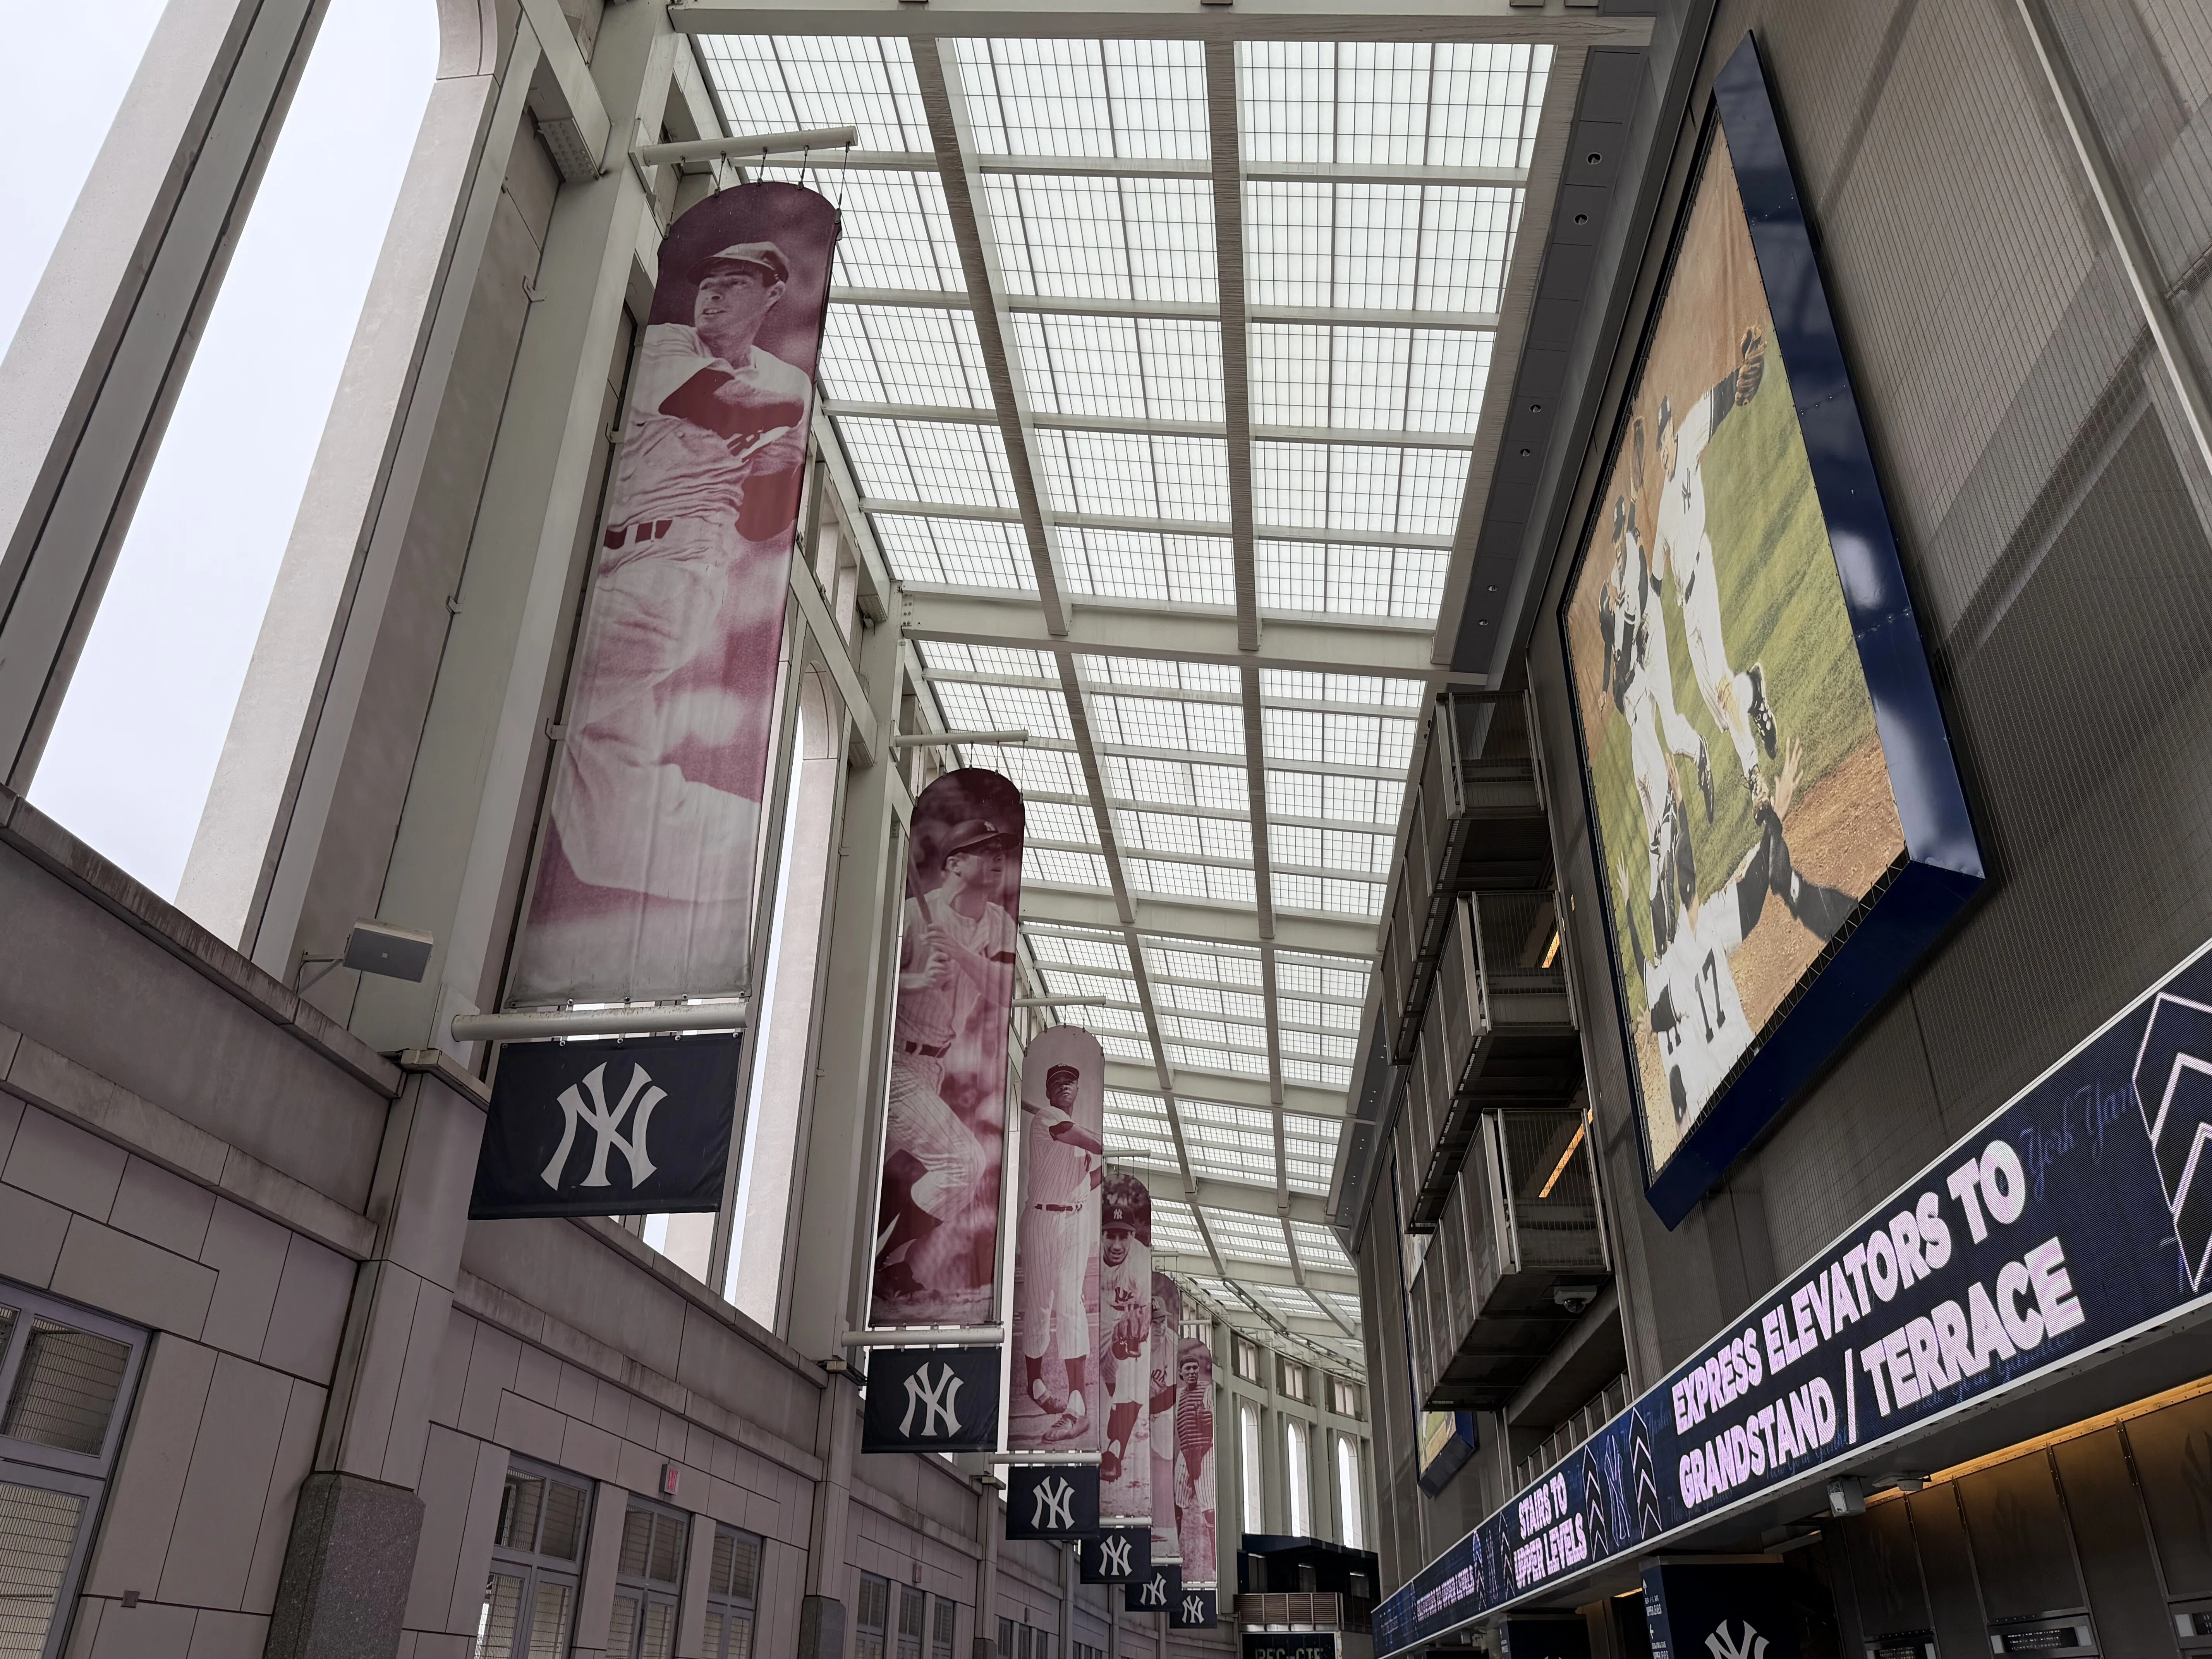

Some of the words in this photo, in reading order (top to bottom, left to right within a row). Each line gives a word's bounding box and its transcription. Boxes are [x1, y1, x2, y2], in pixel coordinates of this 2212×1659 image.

[1694, 948, 1726, 1044] 17
[541, 1061, 668, 1191] NY
[1113, 1208, 1123, 1219] NY
[1672, 1328, 1762, 1435] EXPRESS
[1762, 1192, 1951, 1375] ELEVATORS
[1946, 1140, 2026, 1244] TO
[899, 1362, 964, 1437] NY
[1679, 1377, 1836, 1509] GRANDSTAND
[1860, 1236, 2085, 1417] TERRACE
[1031, 1475, 1075, 1530] NY
[1518, 1484, 1552, 1540] STAIRS
[1550, 1472, 1568, 1519] TO
[1099, 1535, 1133, 1577] NY
[1513, 1537, 1546, 1589] UPPER
[1543, 1512, 1587, 1576] LEVELS
[1140, 1573, 1166, 1605] NY
[1182, 1595, 1205, 1624] NY
